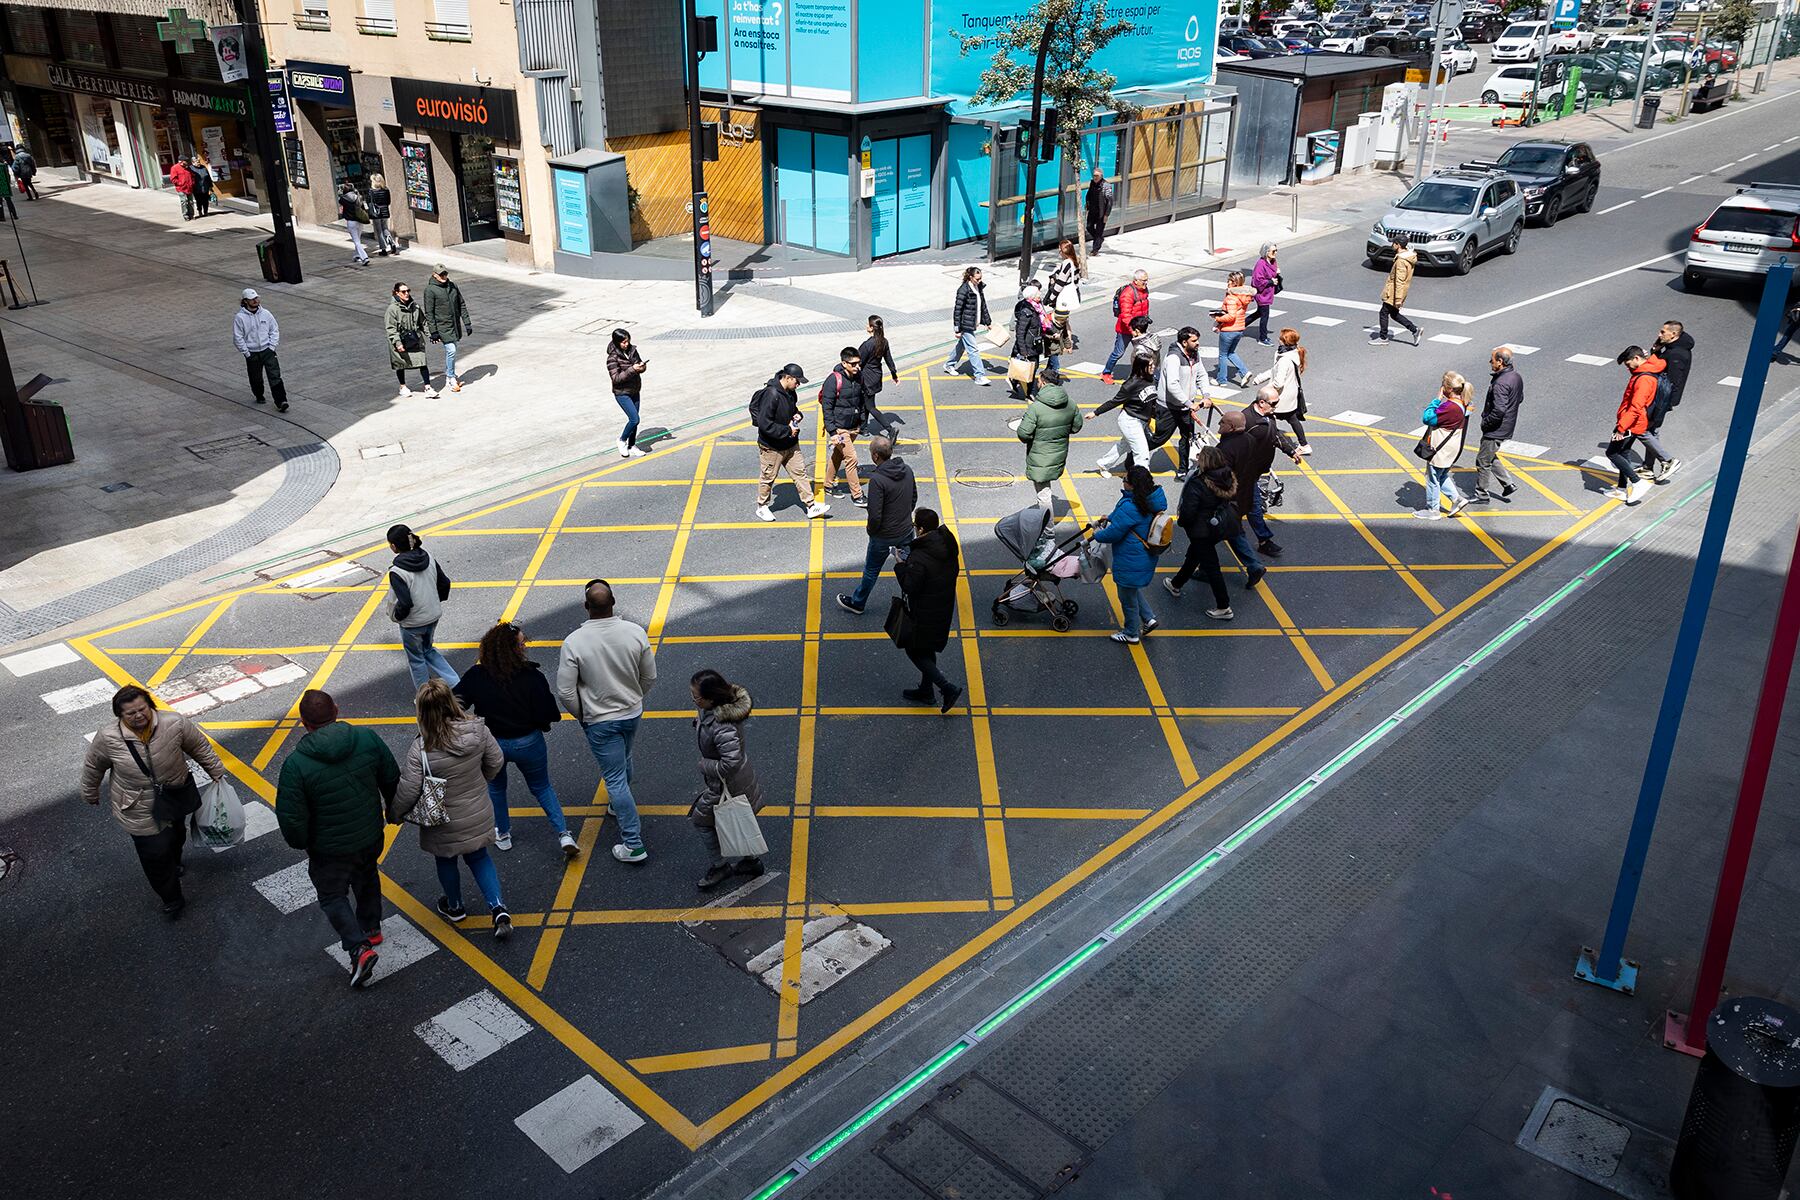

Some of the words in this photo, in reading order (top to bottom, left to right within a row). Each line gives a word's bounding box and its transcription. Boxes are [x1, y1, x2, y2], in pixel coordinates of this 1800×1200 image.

[1560, 0, 1575, 16] P
[962, 13, 1011, 31] Tanquem
[1124, 3, 1147, 20] espai
[1147, 6, 1161, 19] per
[734, 27, 747, 38] Ara
[748, 30, 761, 39] ens
[762, 30, 780, 40] toca
[740, 39, 777, 52] nosaltres.
[1177, 47, 1202, 61] IQOS
[48, 66, 75, 88] GALA
[77, 75, 154, 101] PERFUMERIES
[416, 97, 488, 124] eurovisió
